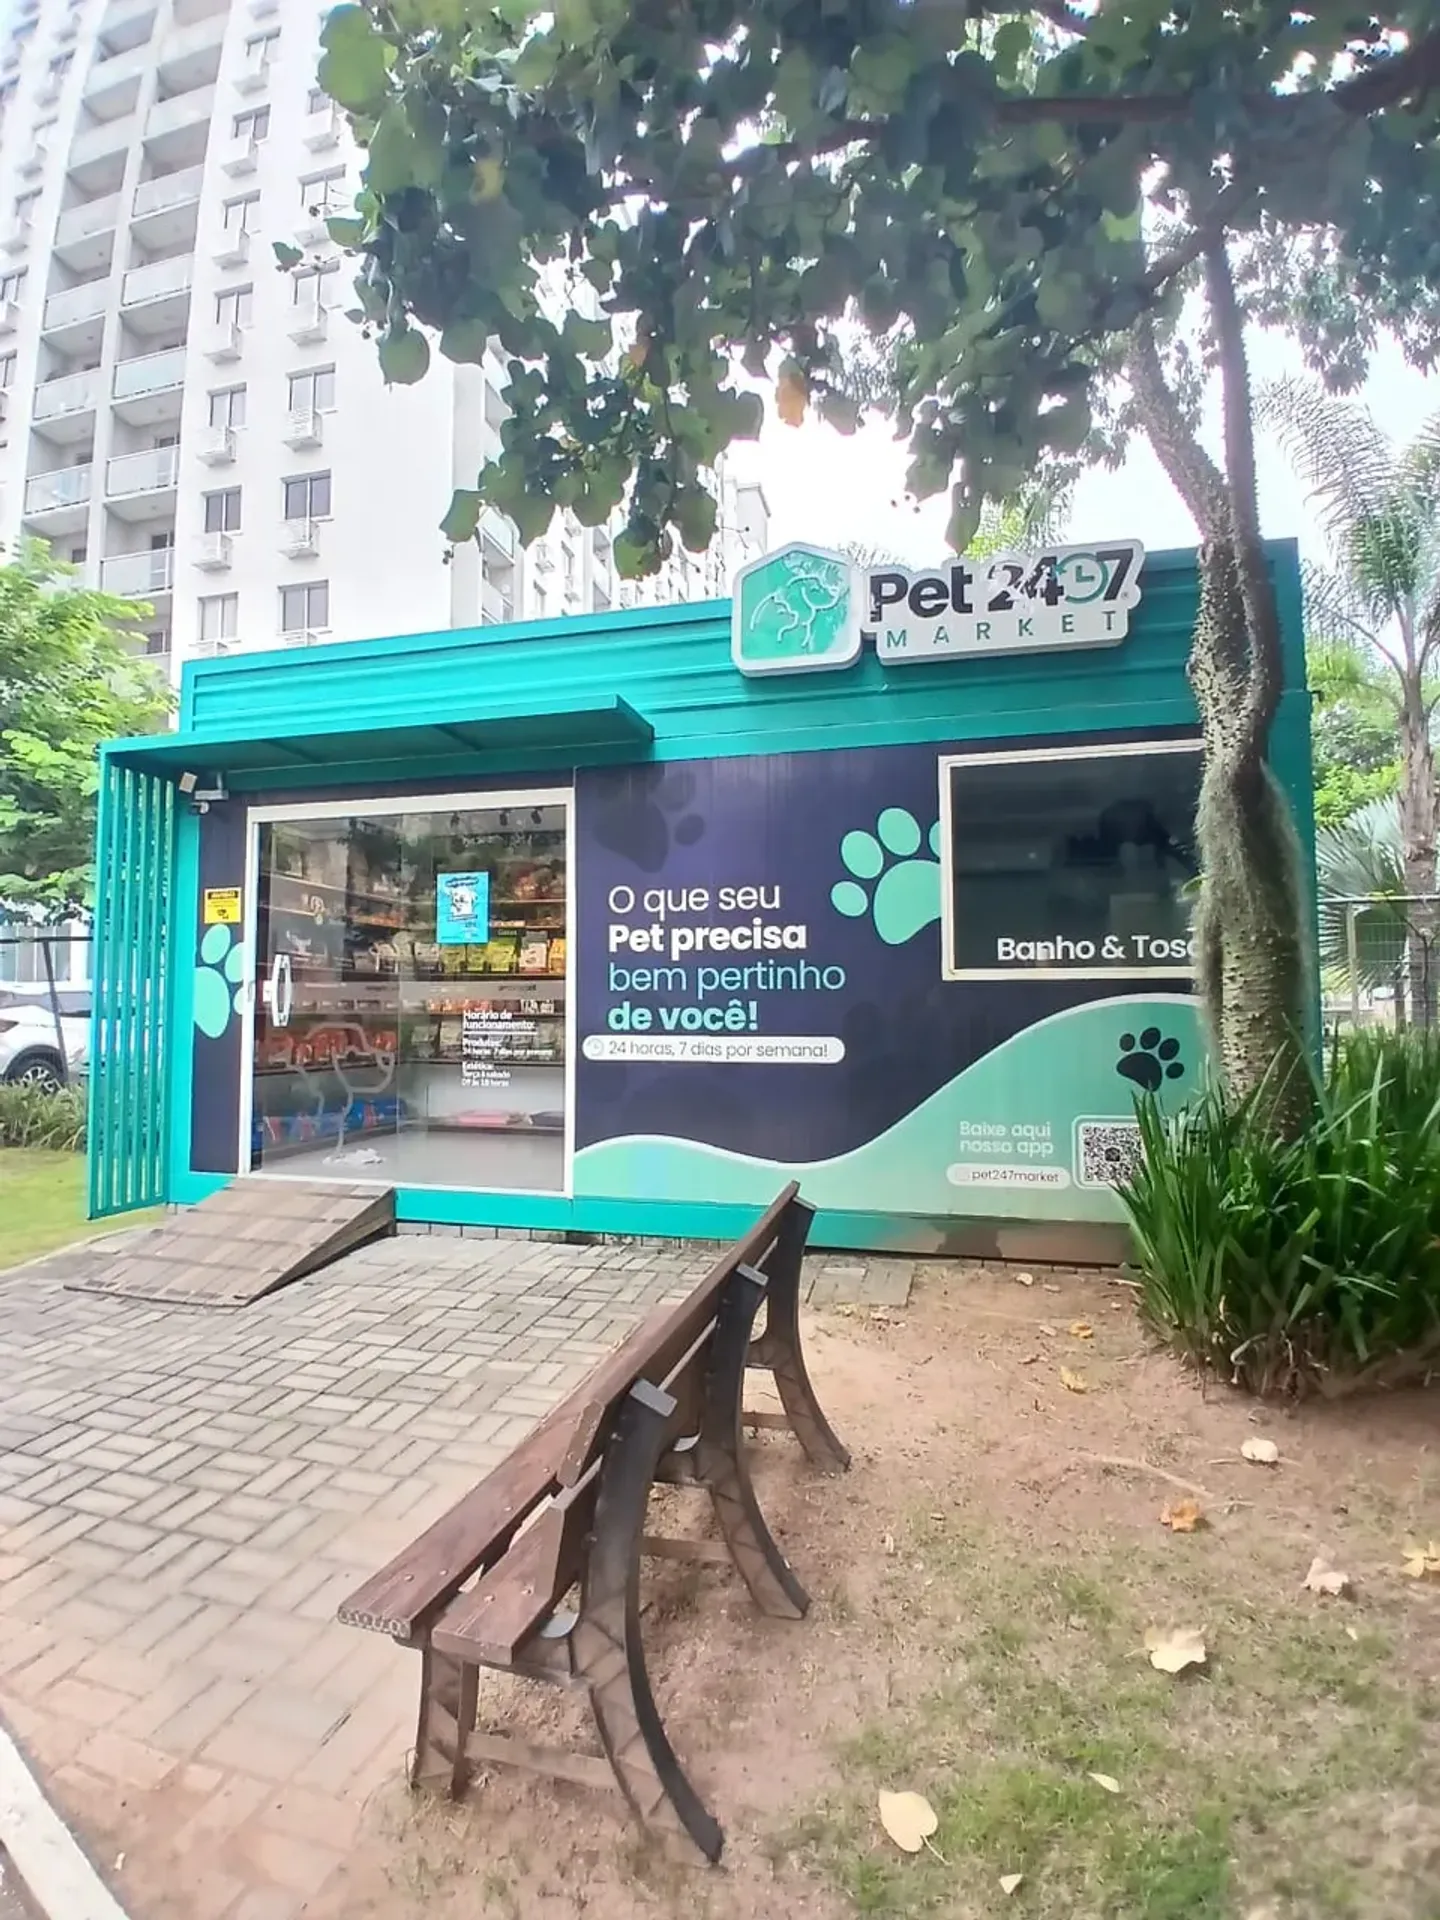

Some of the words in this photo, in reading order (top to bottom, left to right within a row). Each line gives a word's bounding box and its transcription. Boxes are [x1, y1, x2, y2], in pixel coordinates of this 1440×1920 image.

[870, 565, 973, 623] Pet
[886, 610, 1117, 649] MARKET
[608, 885, 636, 914] O
[643, 886, 710, 921] que
[718, 885, 781, 910] seu
[608, 924, 664, 952] Pet
[671, 917, 807, 961] precisa
[997, 936, 1095, 961] Banho
[1101, 936, 1127, 959] &
[609, 962, 687, 991] bem
[698, 959, 846, 1000] pertinho
[500, 1009, 513, 1020] de
[608, 1001, 652, 1031] de
[659, 999, 758, 1031] você!
[608, 1041, 627, 1055] 24
[629, 1041, 675, 1057] horas,
[678, 1041, 688, 1056] 7
[690, 1041, 723, 1057] dias
[725, 1044, 753, 1060] por
[756, 1043, 828, 1058] semana!
[959, 1121, 1006, 1136] Baixe
[1011, 1121, 1052, 1142] aqui
[959, 1139, 1013, 1153] nosso
[1017, 1141, 1054, 1158] app
[971, 1167, 1059, 1183] pet247market
